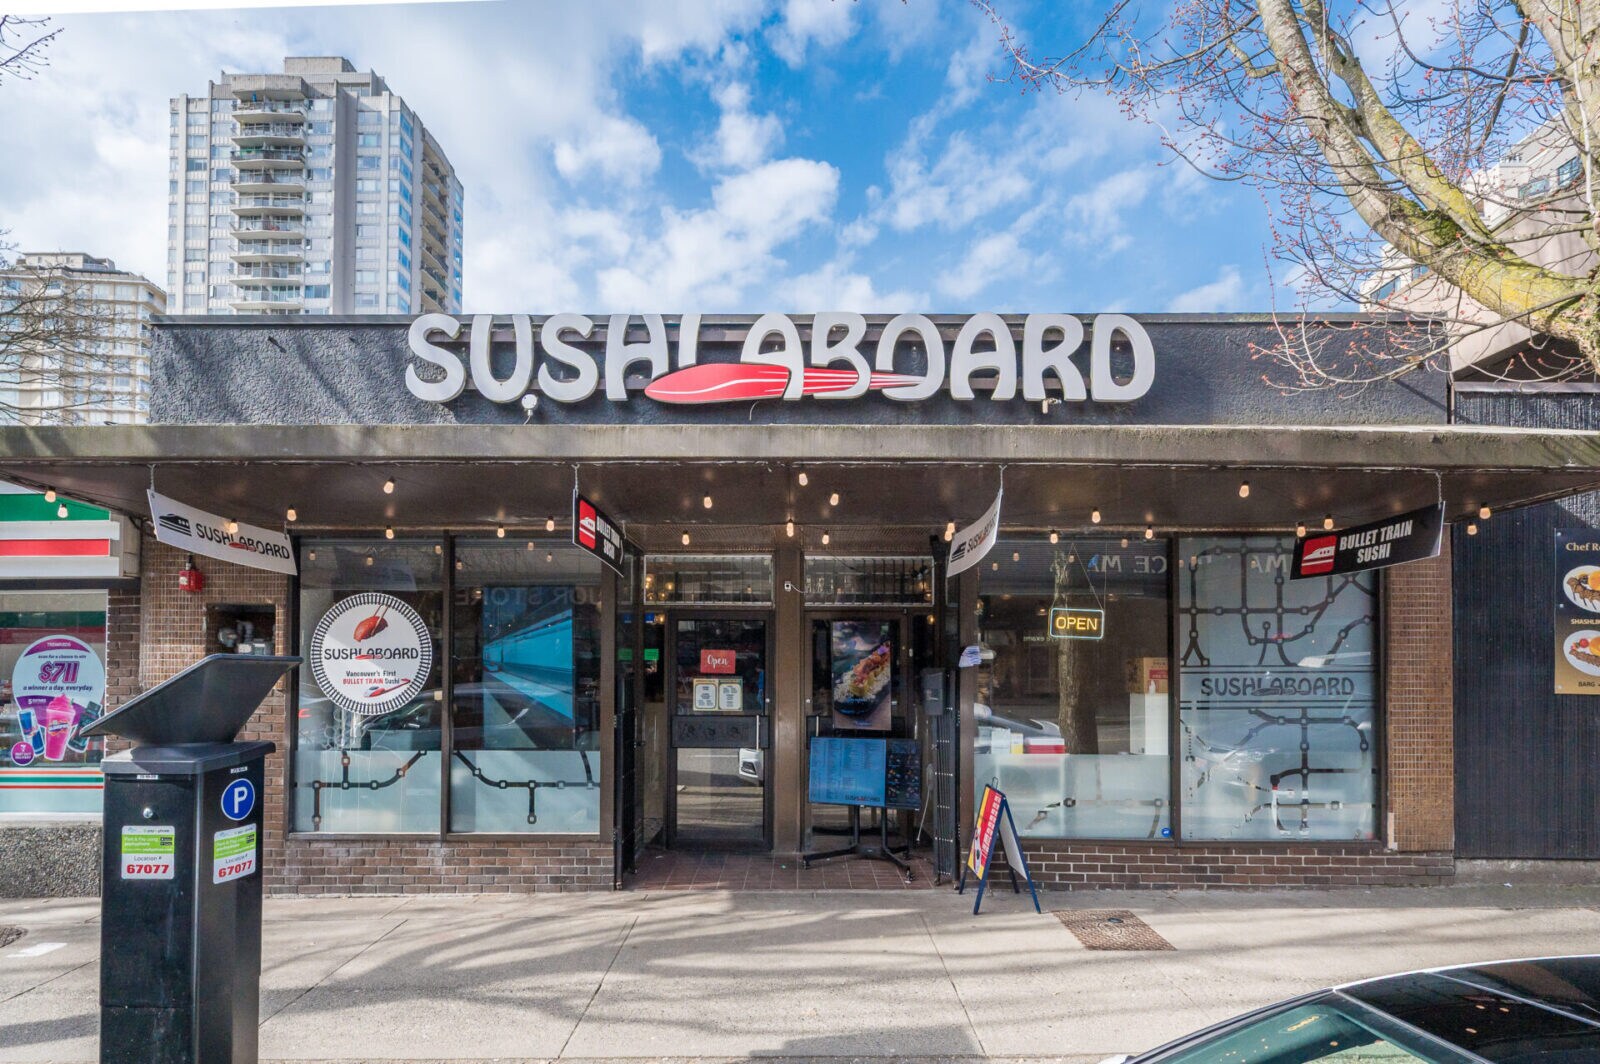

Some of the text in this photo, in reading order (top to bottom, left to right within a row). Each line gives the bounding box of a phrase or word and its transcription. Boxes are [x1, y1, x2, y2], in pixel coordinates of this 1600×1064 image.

[405, 312, 1156, 402] SUSHI ABOARD
[195, 523, 290, 560] SUSHI ABOARD
[1339, 519, 1413, 551] BULLET TRAIN
[1356, 542, 1392, 564] SUSHI
[1565, 542, 1600, 551] Chef R
[1055, 616, 1098, 631] OPEN
[324, 647, 419, 660] SUSHI ABOARD
[707, 654, 729, 669] Open
[38, 660, 80, 684] $711
[384, 677, 400, 685] Sushi
[1201, 677, 1355, 697] SUSHI ABOARD
[233, 786, 248, 814] P
[126, 864, 170, 874] 67077
[218, 860, 252, 878] 67077
